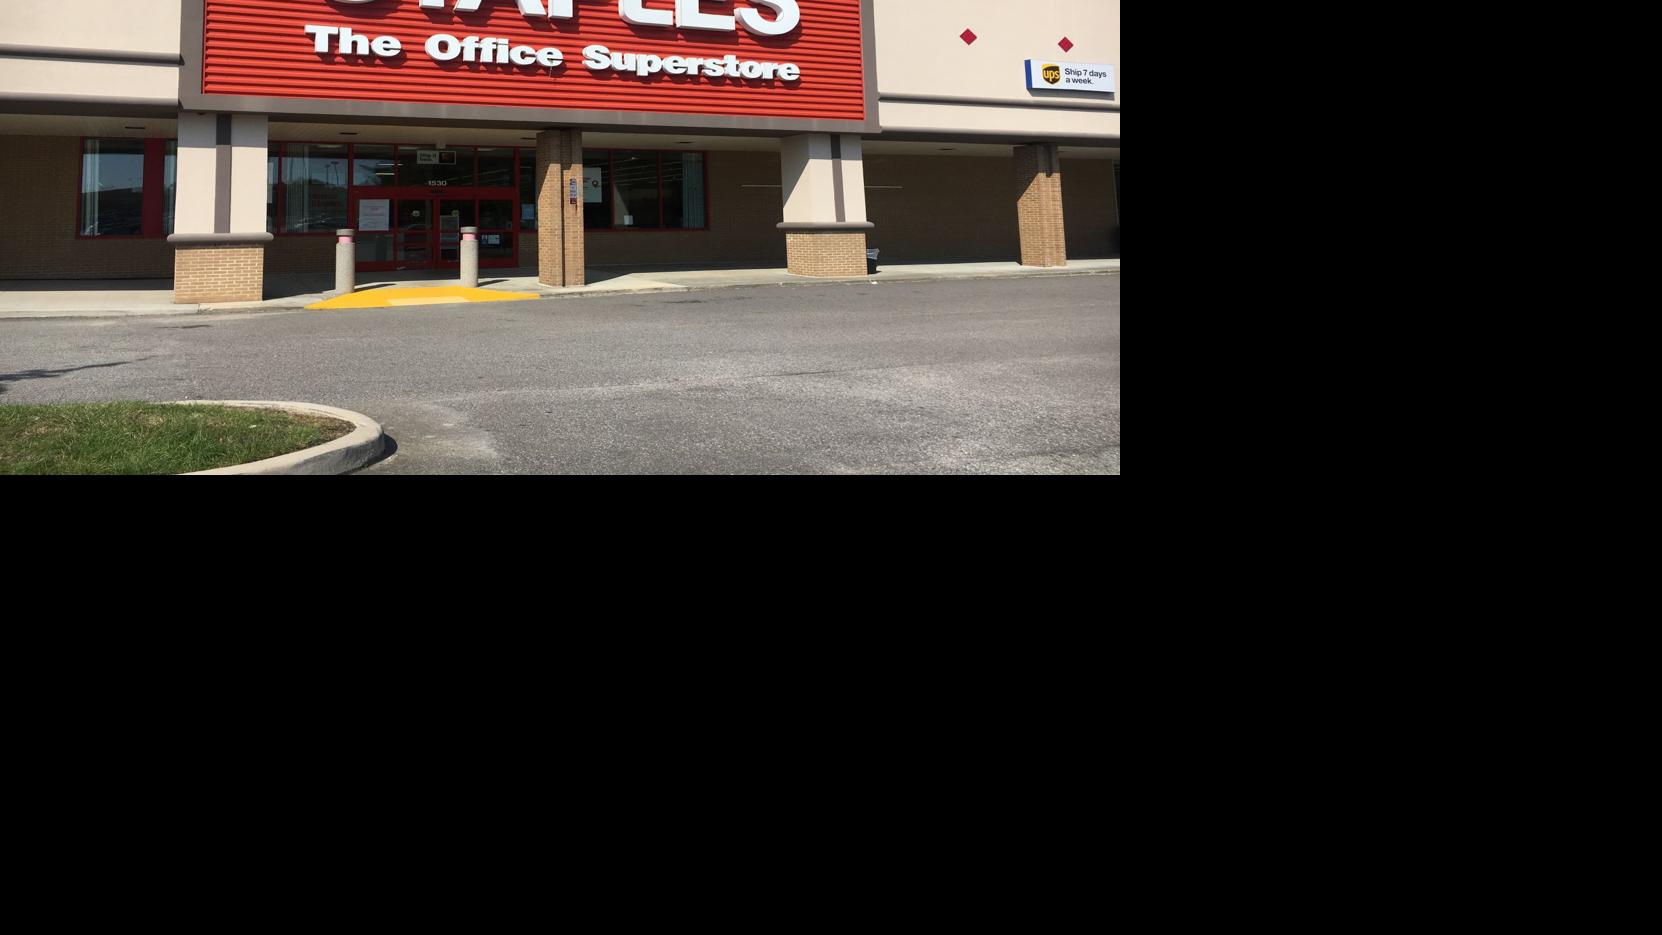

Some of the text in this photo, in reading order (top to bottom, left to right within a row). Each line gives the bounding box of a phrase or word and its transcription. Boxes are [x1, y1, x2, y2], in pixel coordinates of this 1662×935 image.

[304, 25, 800, 81] The Office Superstore
[1043, 70, 1060, 82] ups
[1064, 68, 1082, 77] Ship
[1089, 70, 1107, 79] days
